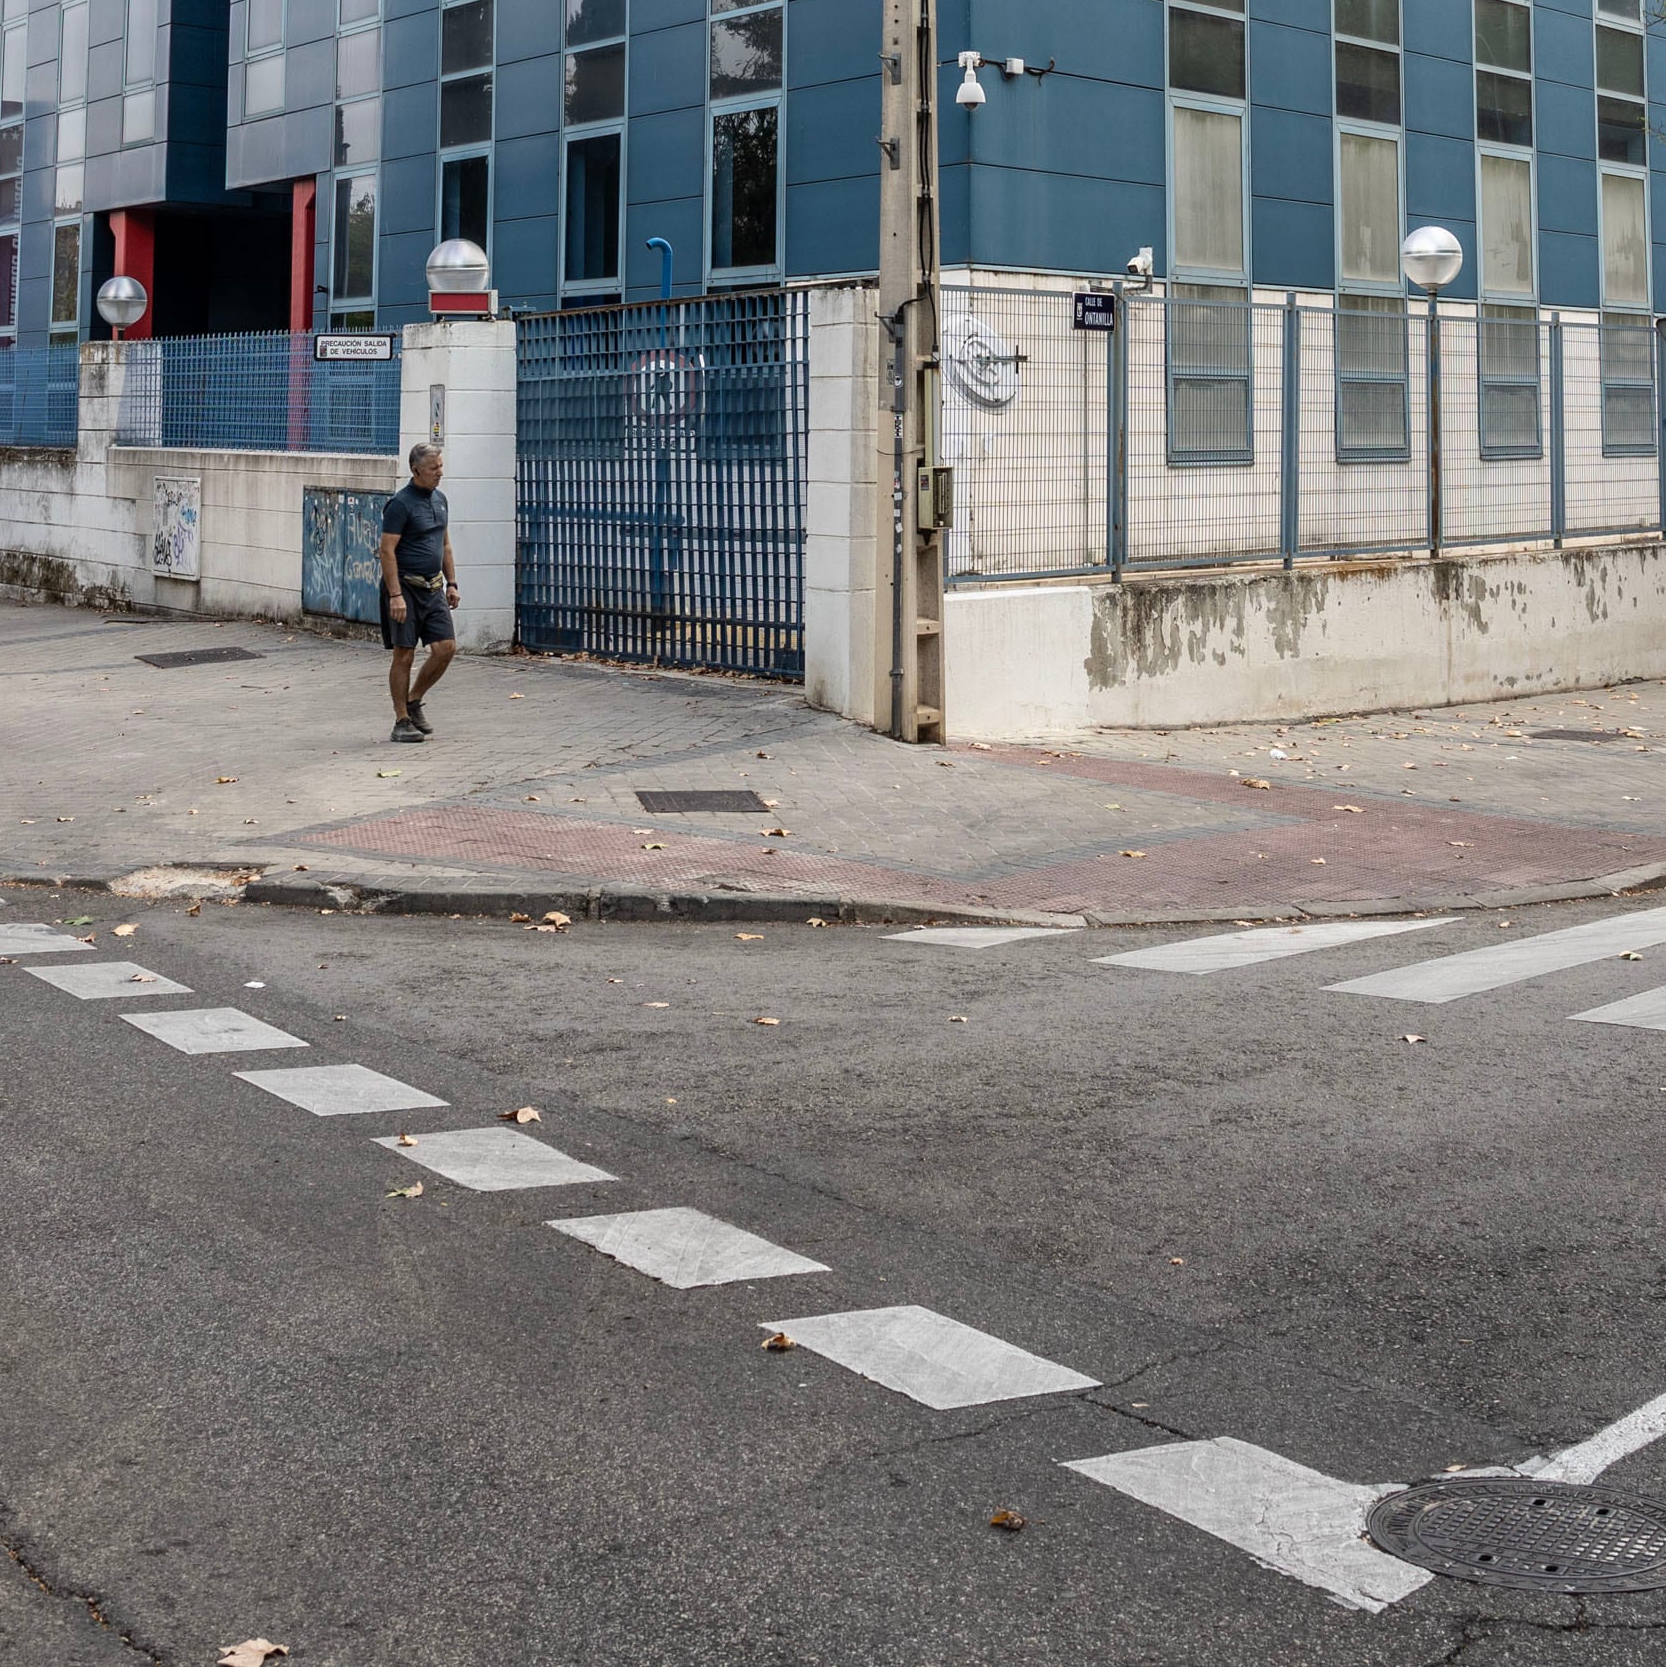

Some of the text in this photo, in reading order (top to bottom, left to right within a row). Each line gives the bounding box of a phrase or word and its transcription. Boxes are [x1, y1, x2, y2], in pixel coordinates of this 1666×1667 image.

[1085, 297, 1103, 307] CALLE DE
[320, 339, 362, 347] PRECAUCIÓN
